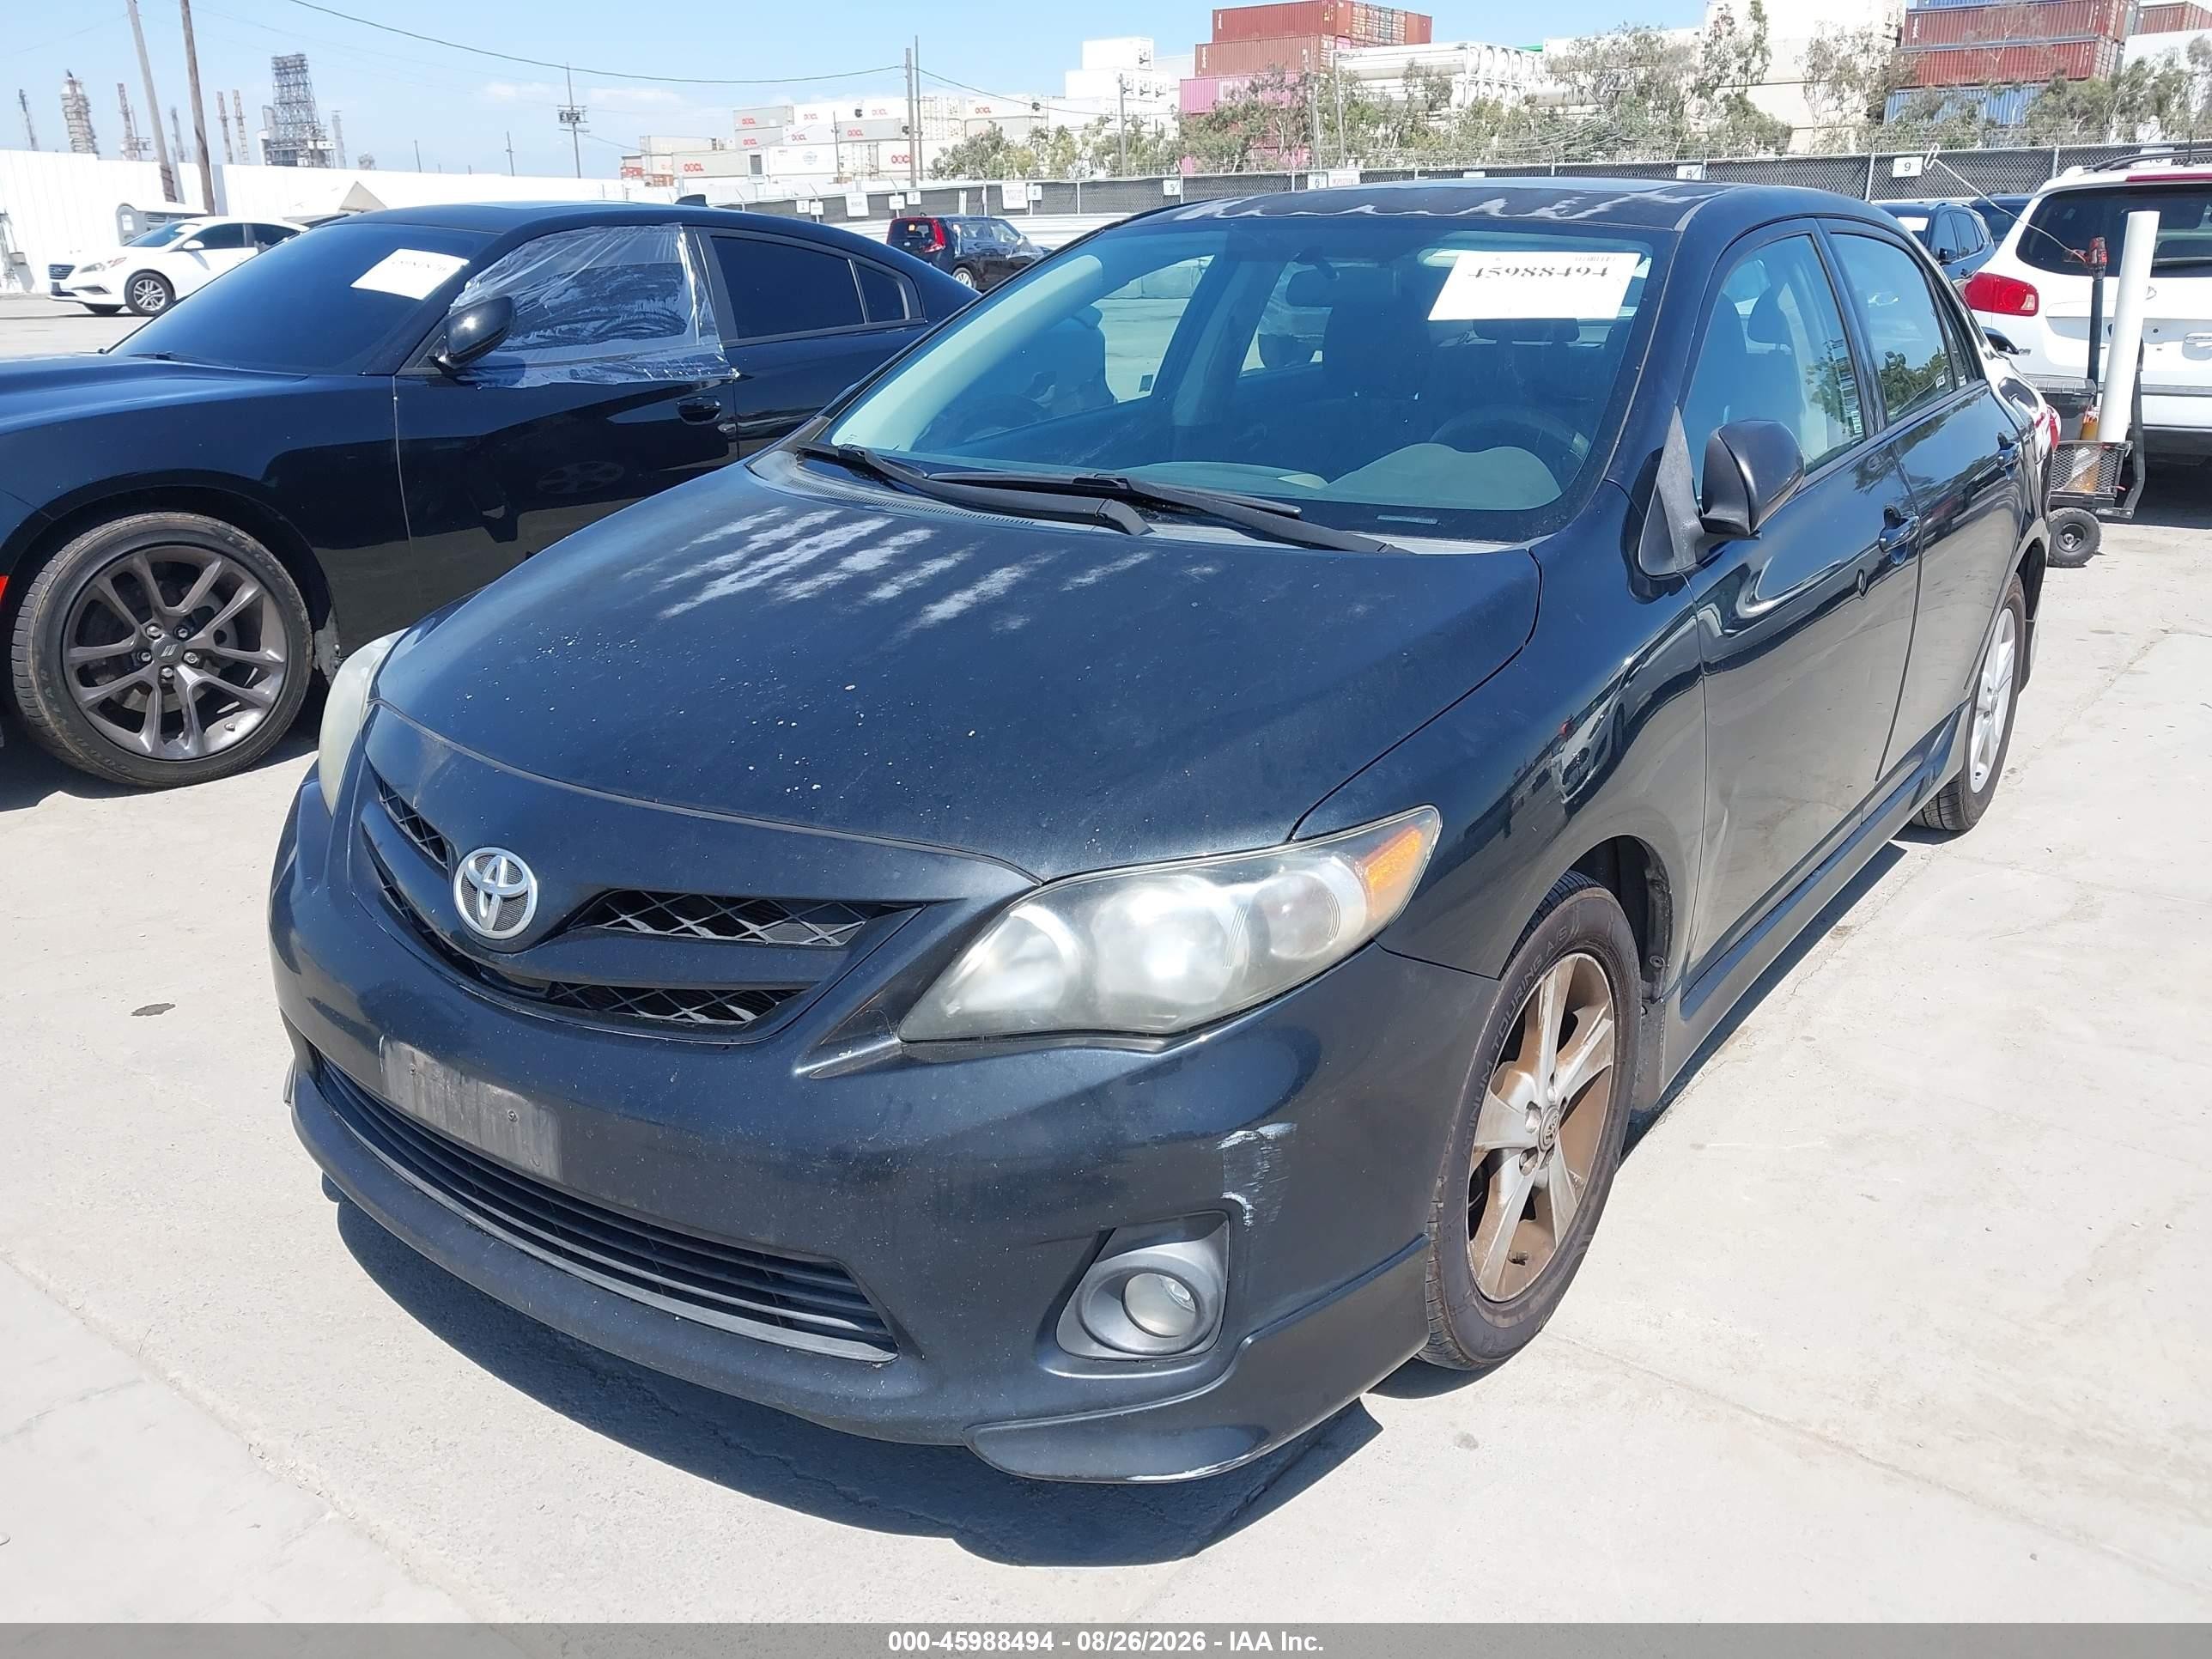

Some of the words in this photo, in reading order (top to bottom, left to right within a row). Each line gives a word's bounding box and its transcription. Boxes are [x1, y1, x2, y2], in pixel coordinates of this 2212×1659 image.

[891, 155, 911, 164] OOC
[1904, 161, 1911, 172] 9
[1468, 265, 1608, 280] 45988494
[1491, 955, 1543, 1057] TOURING
[1546, 924, 1568, 957] A/S
